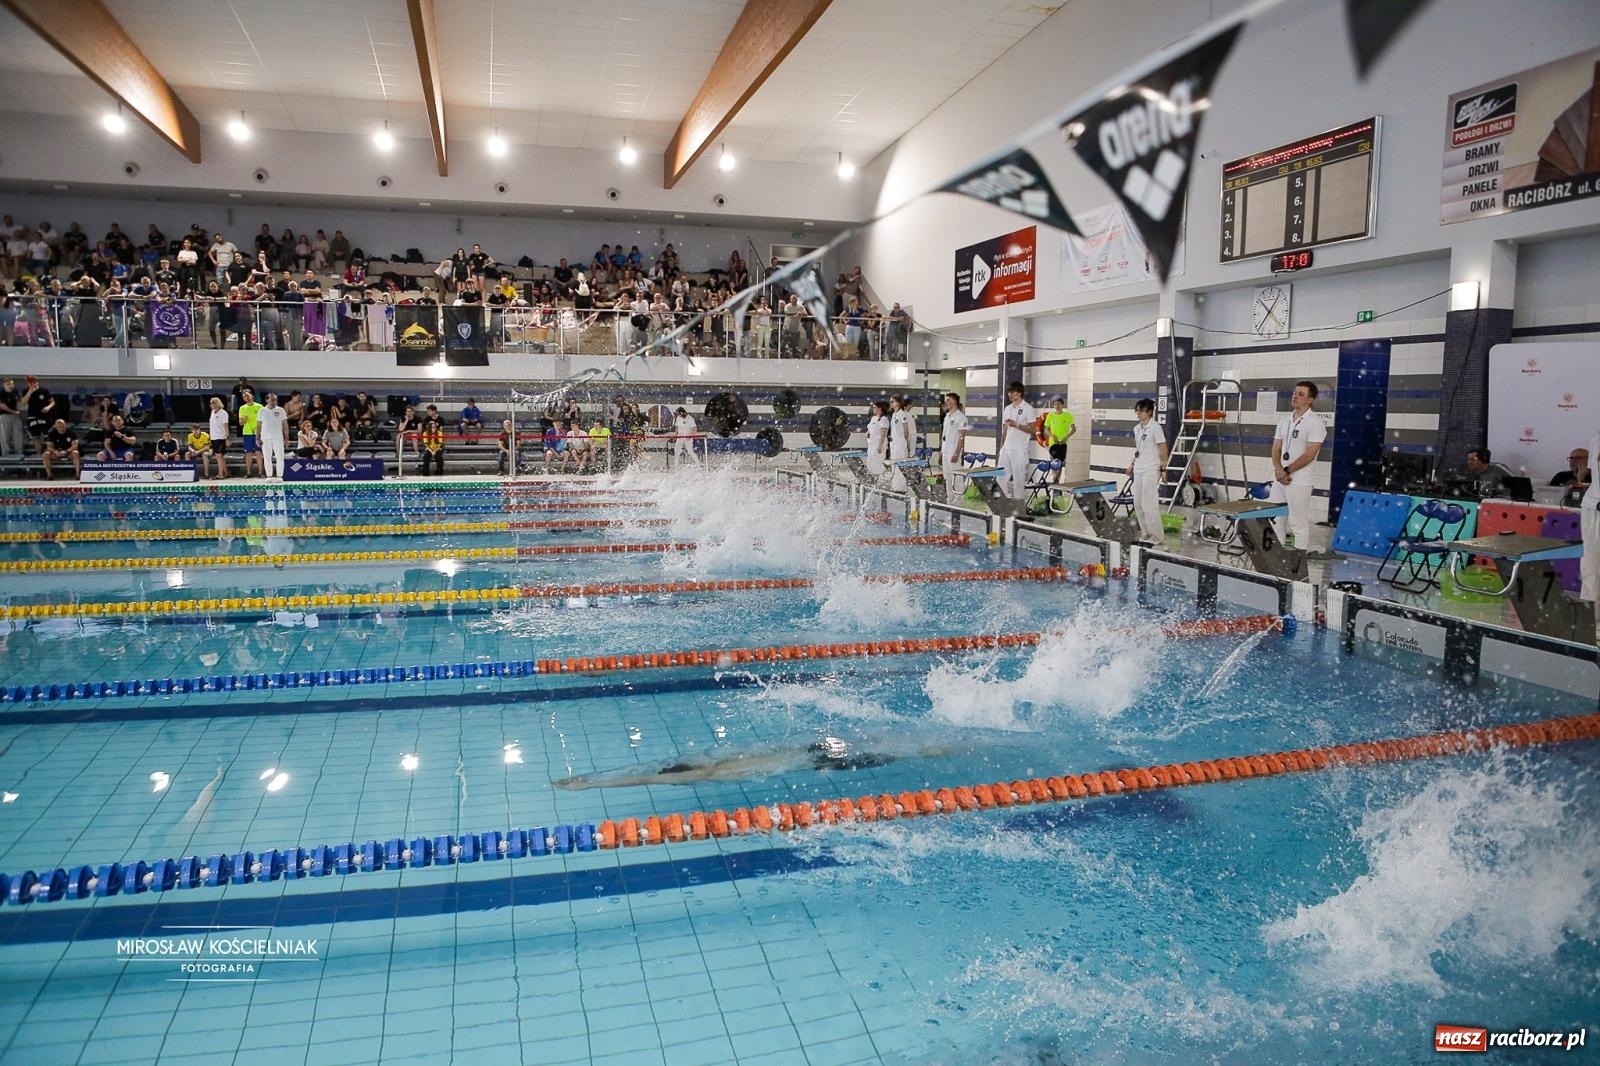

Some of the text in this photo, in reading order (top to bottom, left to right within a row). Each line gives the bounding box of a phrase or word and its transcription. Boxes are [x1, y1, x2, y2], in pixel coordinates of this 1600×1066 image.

[1098, 78, 1194, 170] arena
[1455, 126, 1483, 141] PODŁOGI
[1489, 119, 1513, 133] DRZWI
[1465, 142, 1500, 160] BRAMY
[1468, 160, 1499, 178] DRZWI
[1295, 178, 1304, 187] 5.
[1462, 178, 1497, 196] PANELE
[1226, 196, 1233, 205] 1.
[1294, 196, 1303, 206] 6.
[1508, 181, 1573, 208] RACIBÓRZ
[1578, 181, 1592, 194] ul.
[1470, 197, 1495, 213] OKNA
[1225, 213, 1232, 223] 2.
[1293, 215, 1301, 225] 7.
[1224, 230, 1232, 239] 3.
[1292, 233, 1300, 243] 8.
[1223, 247, 1231, 256] 4.
[993, 255, 1033, 279] informacji
[975, 269, 986, 283] rtk
[1263, 527, 1275, 551] 6
[1542, 571, 1556, 604] 7
[1384, 631, 1419, 646] Colorado
